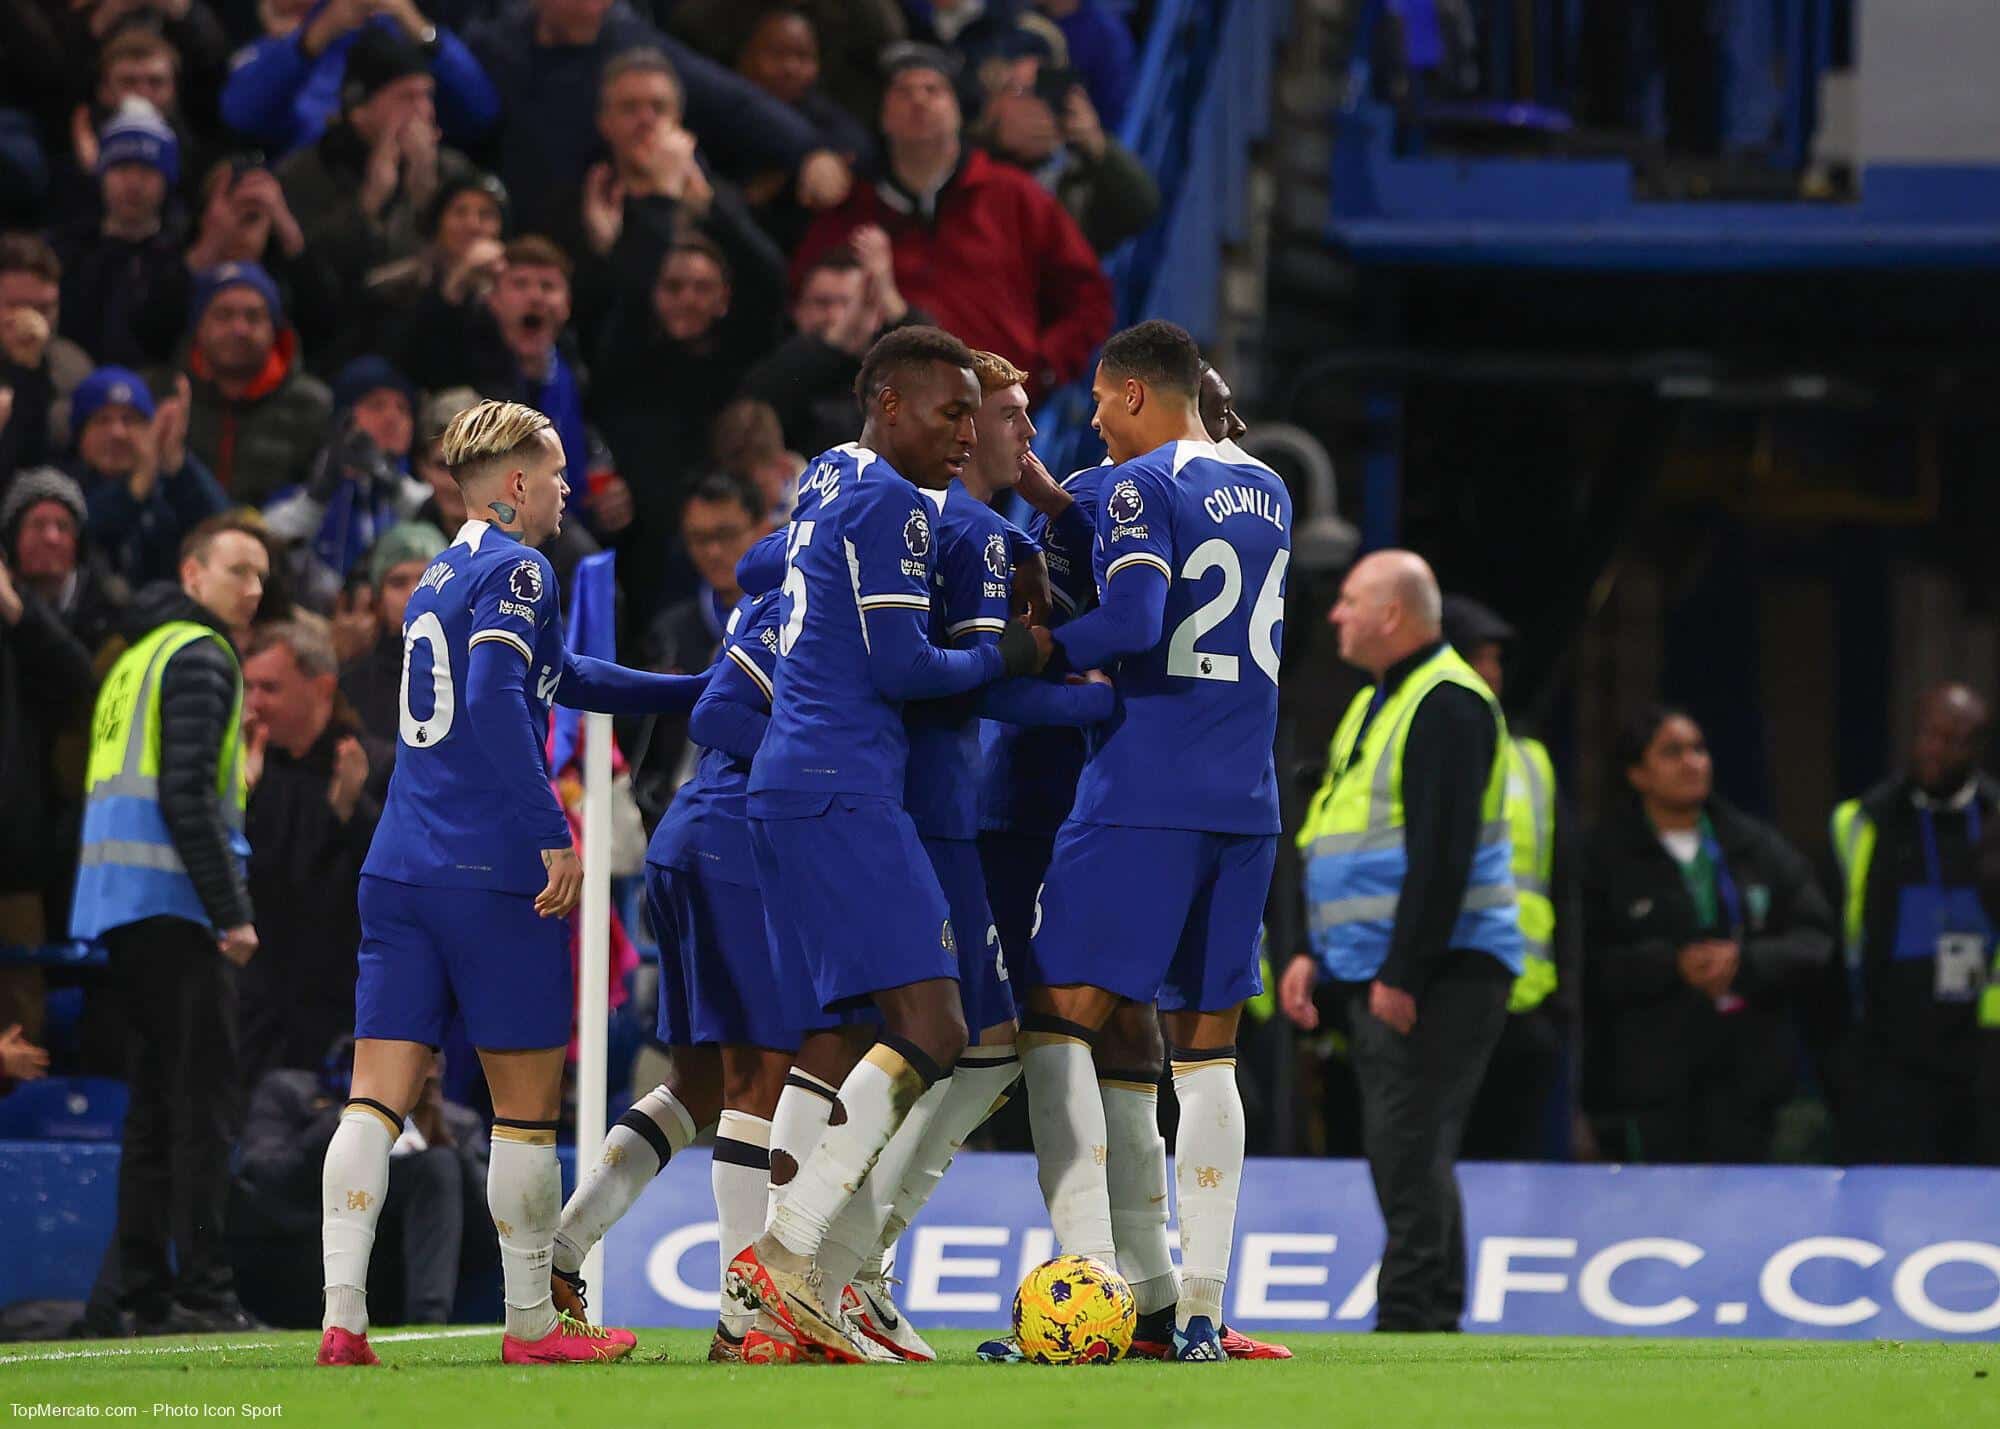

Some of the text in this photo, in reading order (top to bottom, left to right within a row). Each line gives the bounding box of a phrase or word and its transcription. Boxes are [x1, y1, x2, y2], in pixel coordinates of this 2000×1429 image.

[1203, 485, 1285, 531] COLWILL
[1046, 551, 1070, 568] room
[499, 599, 514, 610] No
[983, 581, 997, 591] No
[760, 626, 776, 641] No
[1166, 537, 1291, 687] 26
[399, 611, 455, 749] 0
[986, 923, 1009, 982] 2
[645, 1220, 2000, 1334] CEEFC.CO
